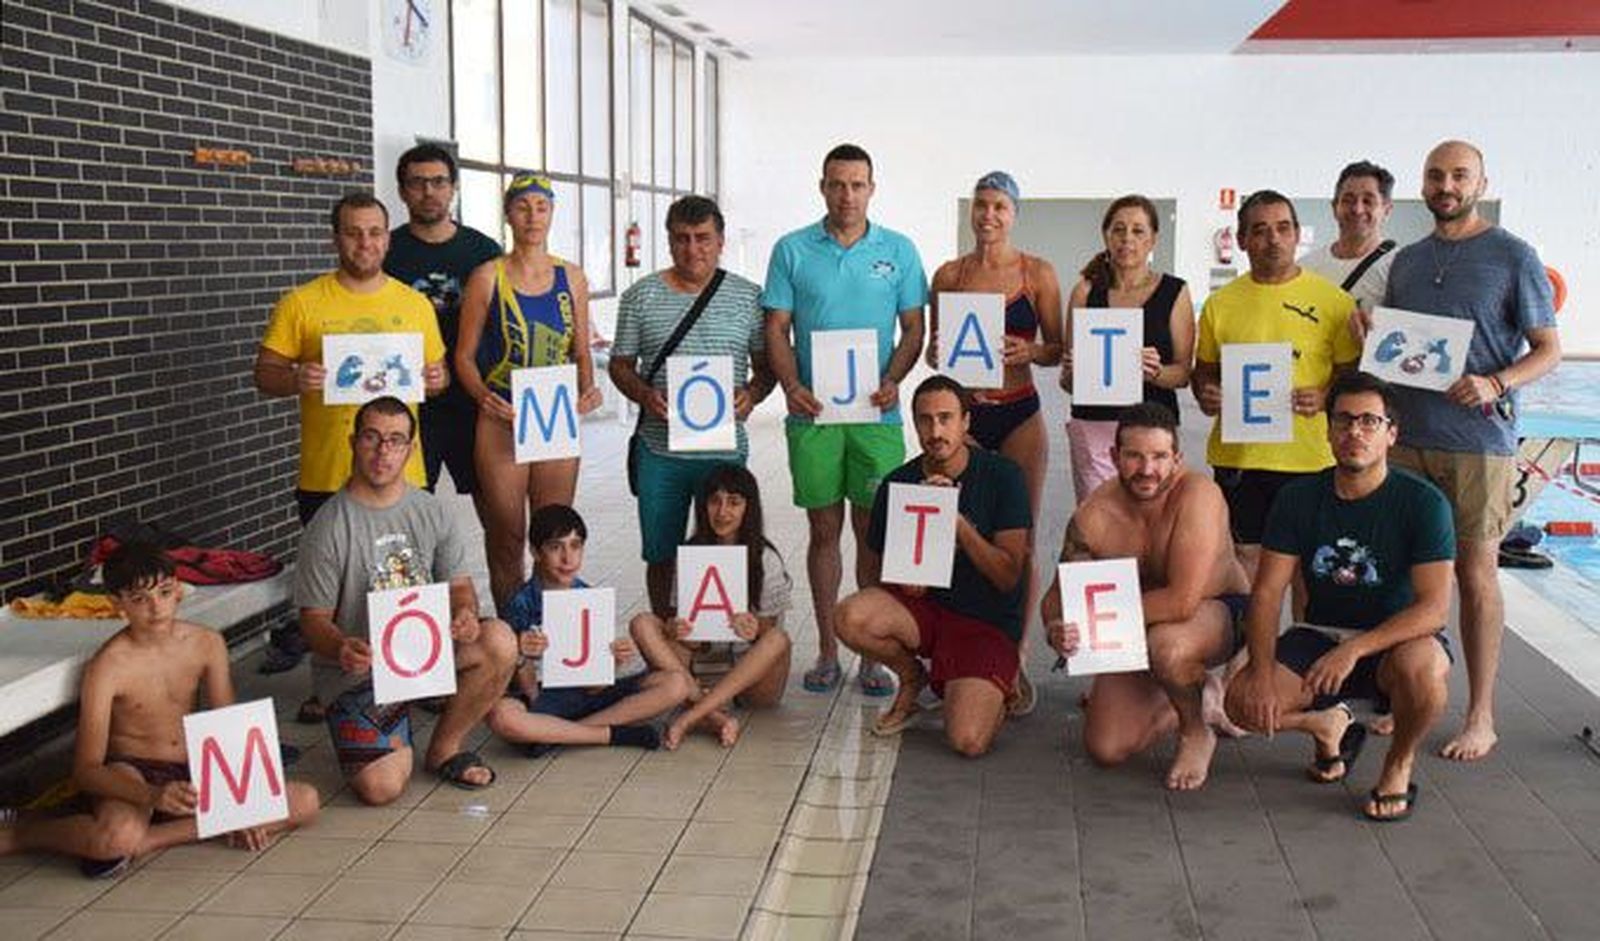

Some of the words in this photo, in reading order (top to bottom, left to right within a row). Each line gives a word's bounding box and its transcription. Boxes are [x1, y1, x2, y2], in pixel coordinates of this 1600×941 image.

[948, 312, 993, 370] A
[1091, 328, 1126, 387] T
[677, 362, 726, 430] Ó
[833, 349, 857, 406] J
[1242, 363, 1272, 424] E
[519, 384, 577, 442] M
[904, 504, 940, 564] T
[686, 564, 735, 626] A
[1084, 583, 1121, 650] E
[381, 592, 441, 678] Ó
[563, 608, 590, 668] J
[198, 727, 280, 813] M
